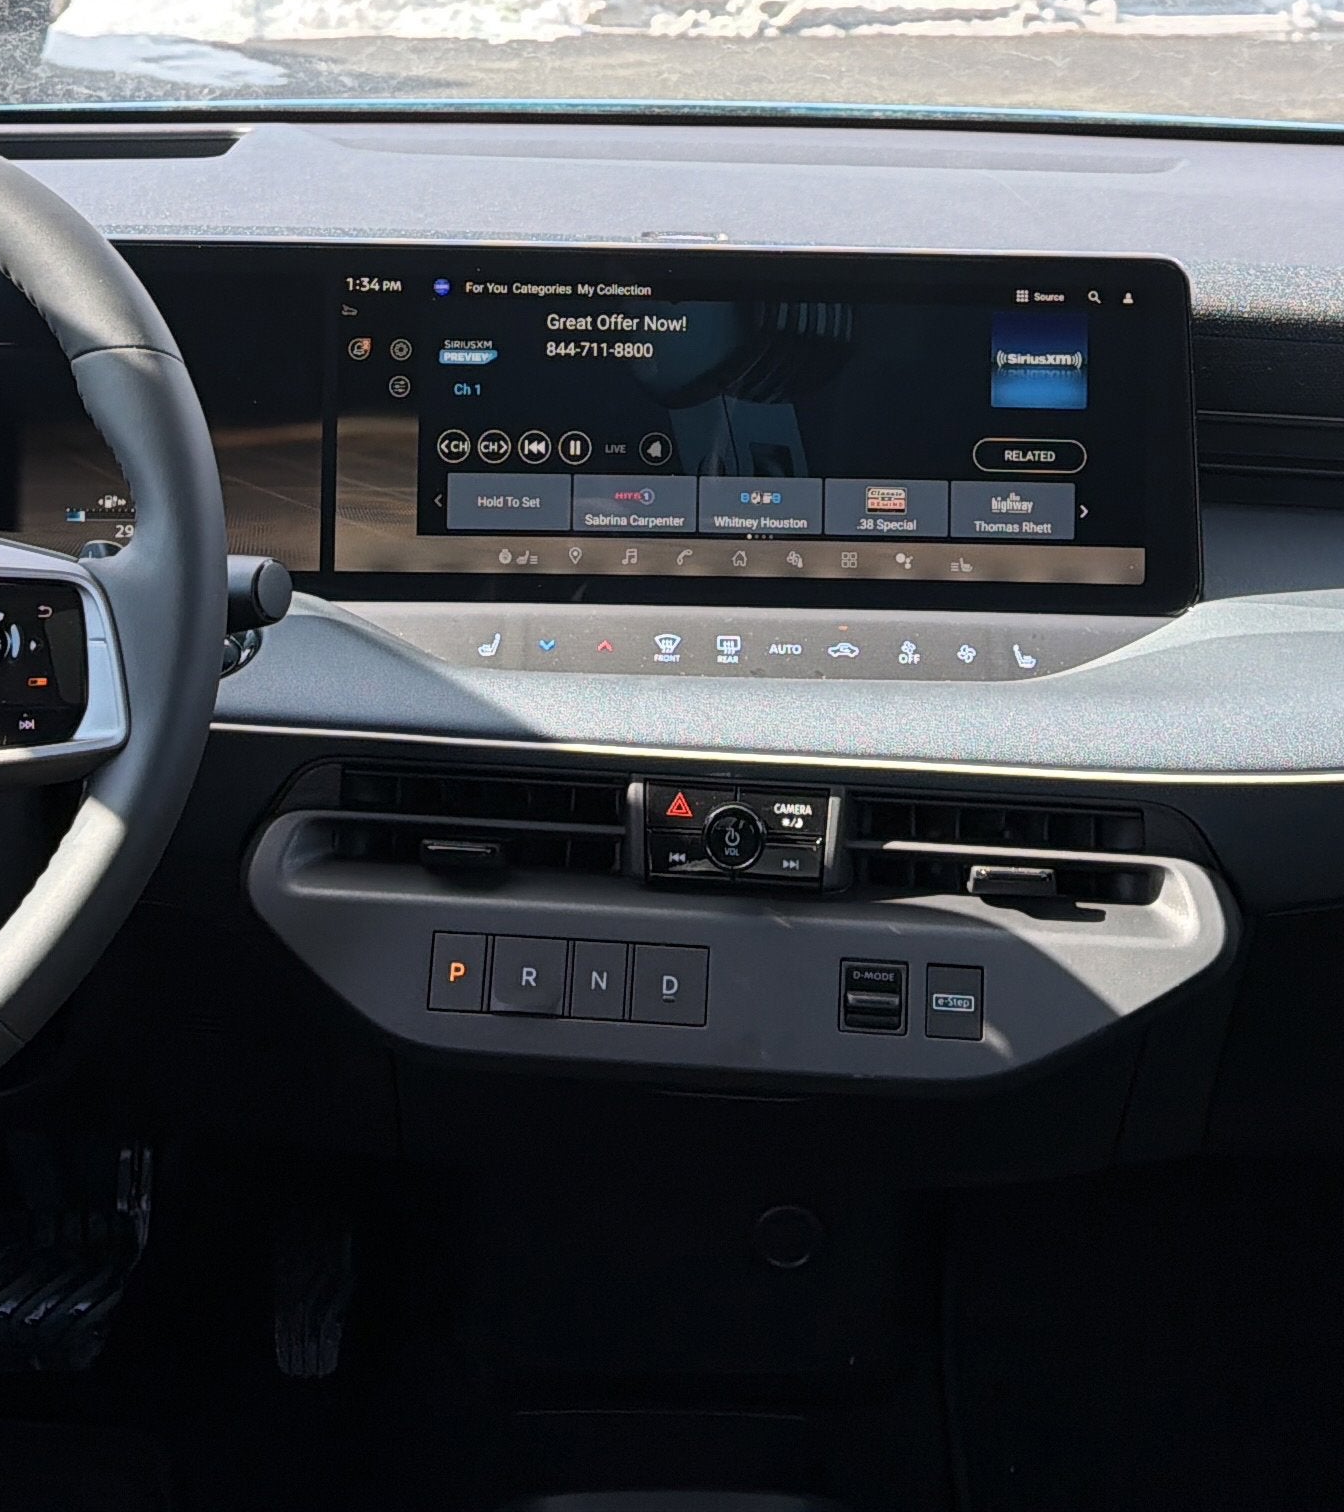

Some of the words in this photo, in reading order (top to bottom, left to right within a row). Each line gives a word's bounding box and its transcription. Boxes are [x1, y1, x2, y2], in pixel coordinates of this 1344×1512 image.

[345, 277, 380, 291] 1:34
[382, 281, 402, 291] PM
[466, 282, 484, 294] For
[486, 282, 508, 294] You
[512, 283, 572, 296] Categories
[577, 283, 595, 297] My
[597, 284, 652, 296] Collection
[1034, 293, 1064, 302] Source
[547, 314, 592, 329] Great
[597, 315, 640, 330] Offer
[644, 315, 687, 331] Now!
[444, 340, 492, 349] SIRIUSXM
[546, 342, 653, 358] 844-711-8800
[454, 383, 471, 395] Ch
[474, 383, 481, 395] 1
[605, 444, 626, 454] LIVE
[1004, 450, 1055, 462] RELATED
[477, 496, 503, 508] Hold
[506, 497, 519, 508] To
[522, 497, 540, 508] Set
[1010, 492, 1021, 500] the
[870, 500, 904, 508] REWIND
[992, 496, 1034, 513] highway
[585, 514, 627, 526] Sabrina
[630, 515, 684, 528] Carpenter
[714, 516, 758, 530] Whitney
[761, 516, 808, 528] Houston
[856, 520, 874, 530] .38
[877, 520, 917, 533] Special
[974, 520, 1019, 533] Thomas
[1022, 521, 1052, 533] Rhett
[769, 644, 801, 655] AUTO
[654, 654, 680, 663] FRONT
[717, 655, 738, 663] REAR
[899, 654, 920, 664] OFF
[774, 803, 812, 815] CAMERA
[725, 847, 739, 856] VOL
[450, 962, 465, 982] P
[521, 967, 536, 987] R
[591, 972, 607, 990] N
[662, 976, 678, 994] D
[853, 971, 895, 981] D-MODE
[938, 996, 969, 1008] e-Step
